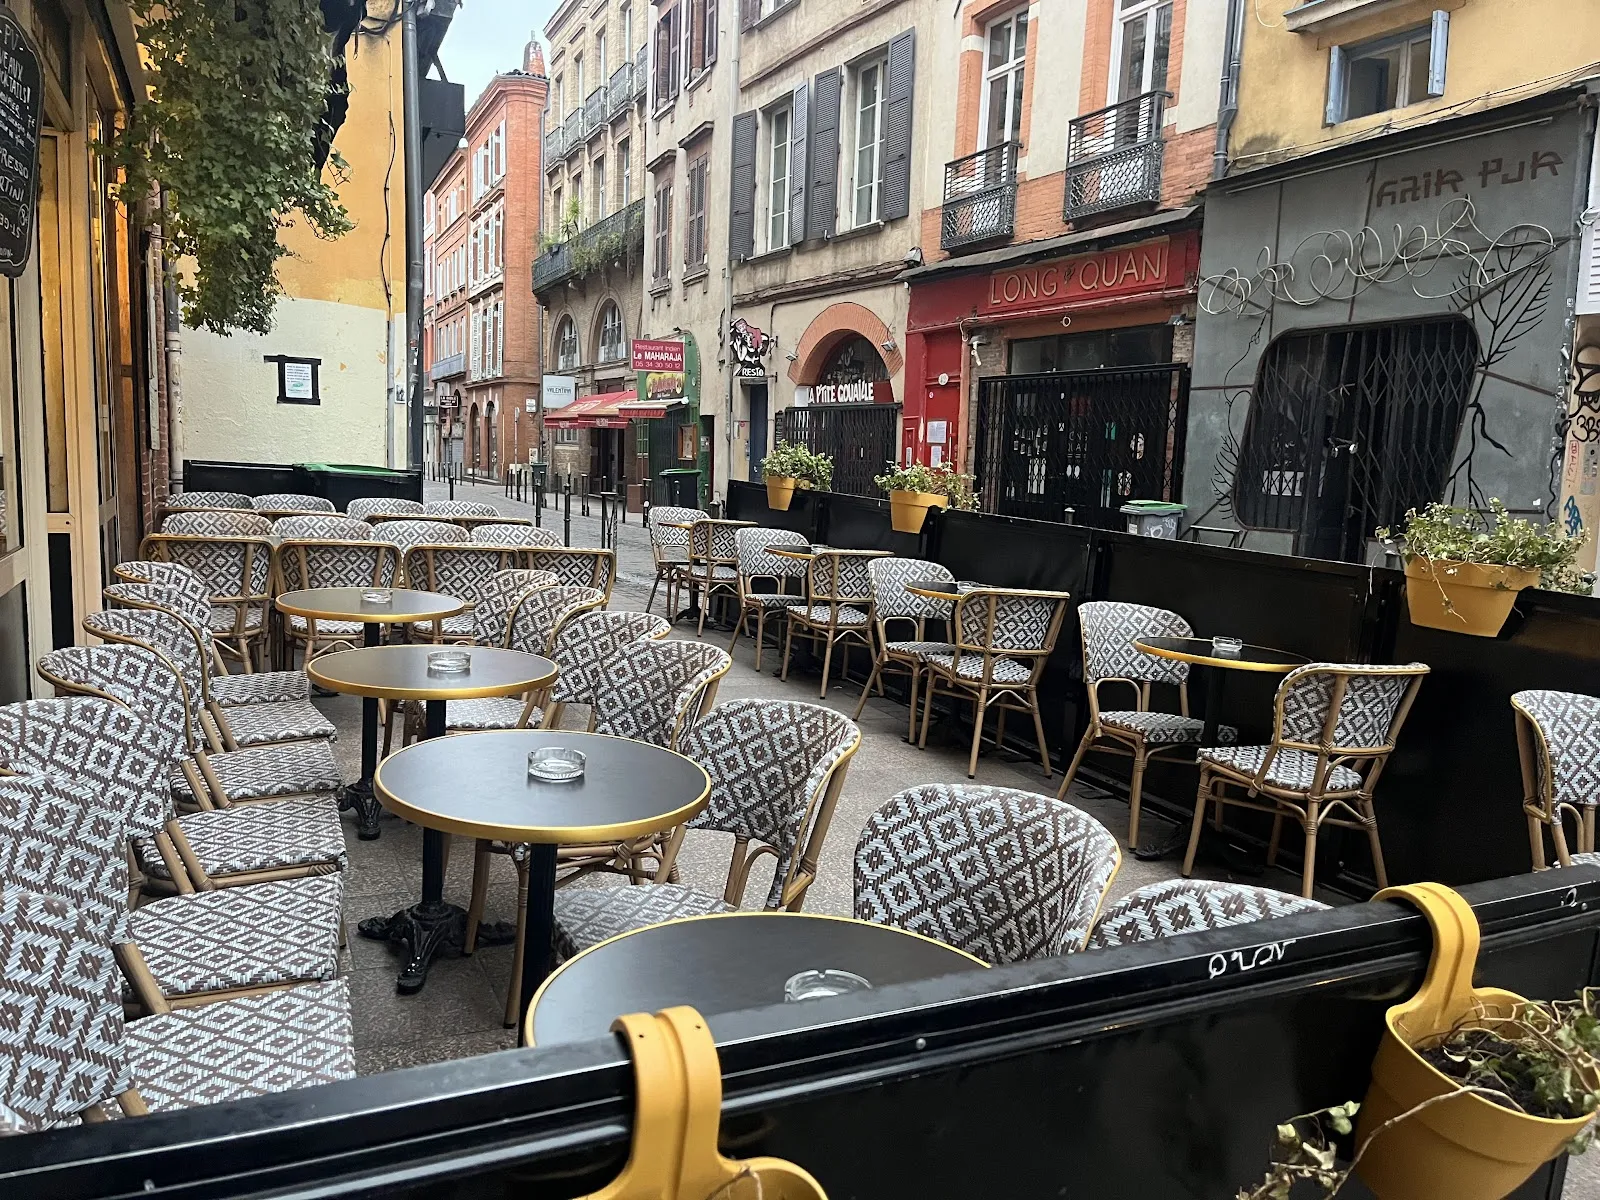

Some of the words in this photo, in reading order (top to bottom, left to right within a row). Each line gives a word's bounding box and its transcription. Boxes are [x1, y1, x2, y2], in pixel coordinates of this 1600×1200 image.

[990, 267, 1059, 305] LONG
[1079, 248, 1161, 290] QUAN
[634, 343, 664, 351] Restaurant
[633, 350, 643, 360] Le
[644, 351, 683, 362] MAHARAJA
[742, 368, 764, 377] RESTO
